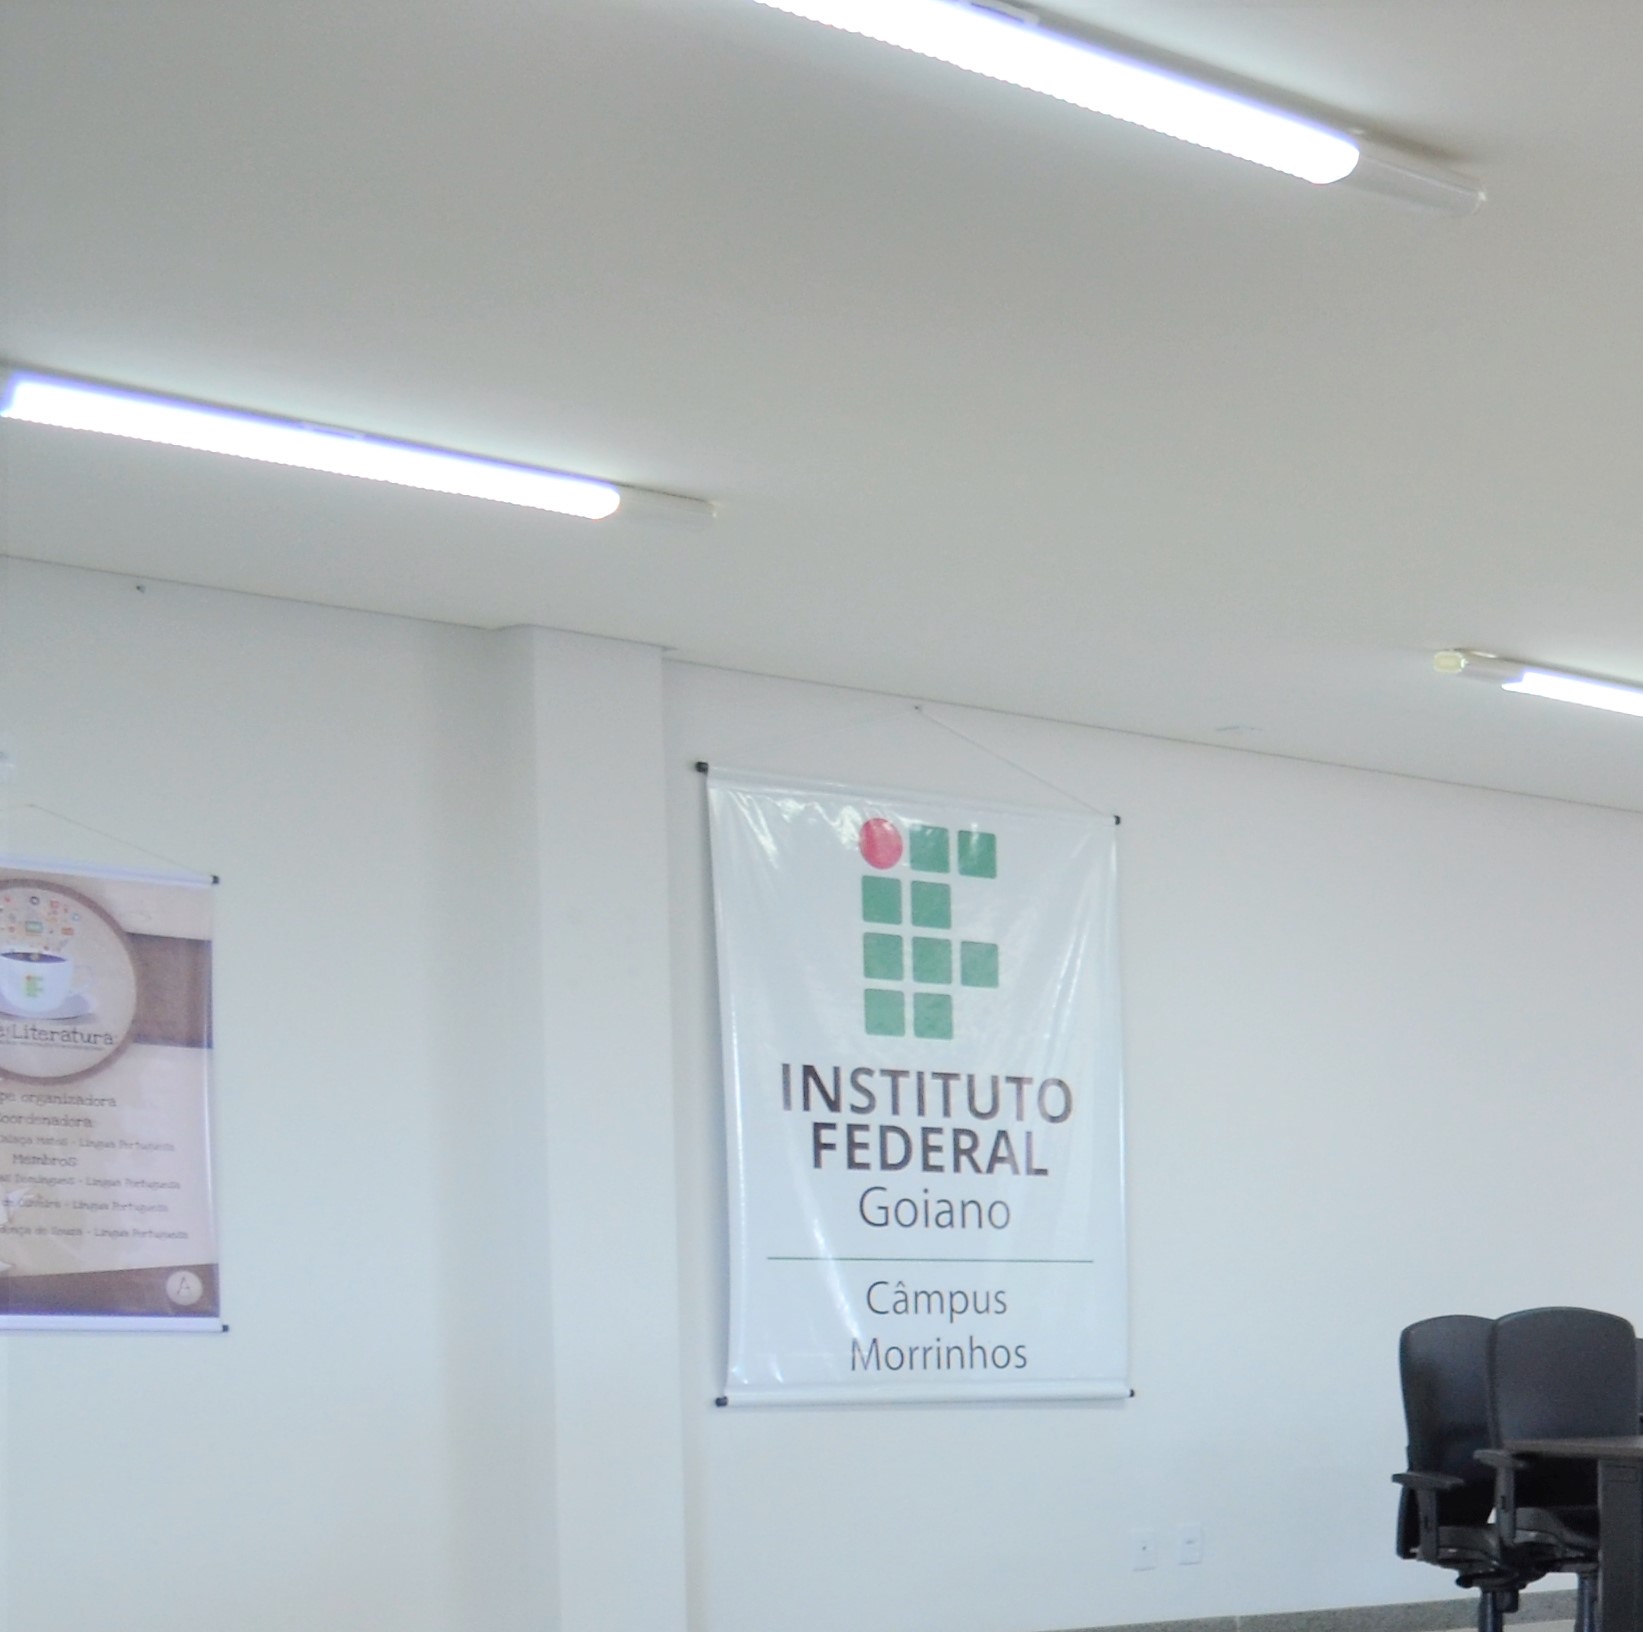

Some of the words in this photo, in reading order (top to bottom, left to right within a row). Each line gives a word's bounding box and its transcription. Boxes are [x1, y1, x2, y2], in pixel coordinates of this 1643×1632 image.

[781, 1062, 1074, 1124] INSTITUTO
[12, 1153, 79, 1168] Membros
[812, 1121, 1049, 1176] FEDERAL
[859, 1186, 1011, 1230] Goiano
[866, 1280, 1008, 1323] Câmpus
[850, 1335, 1028, 1372] Morrinhos
